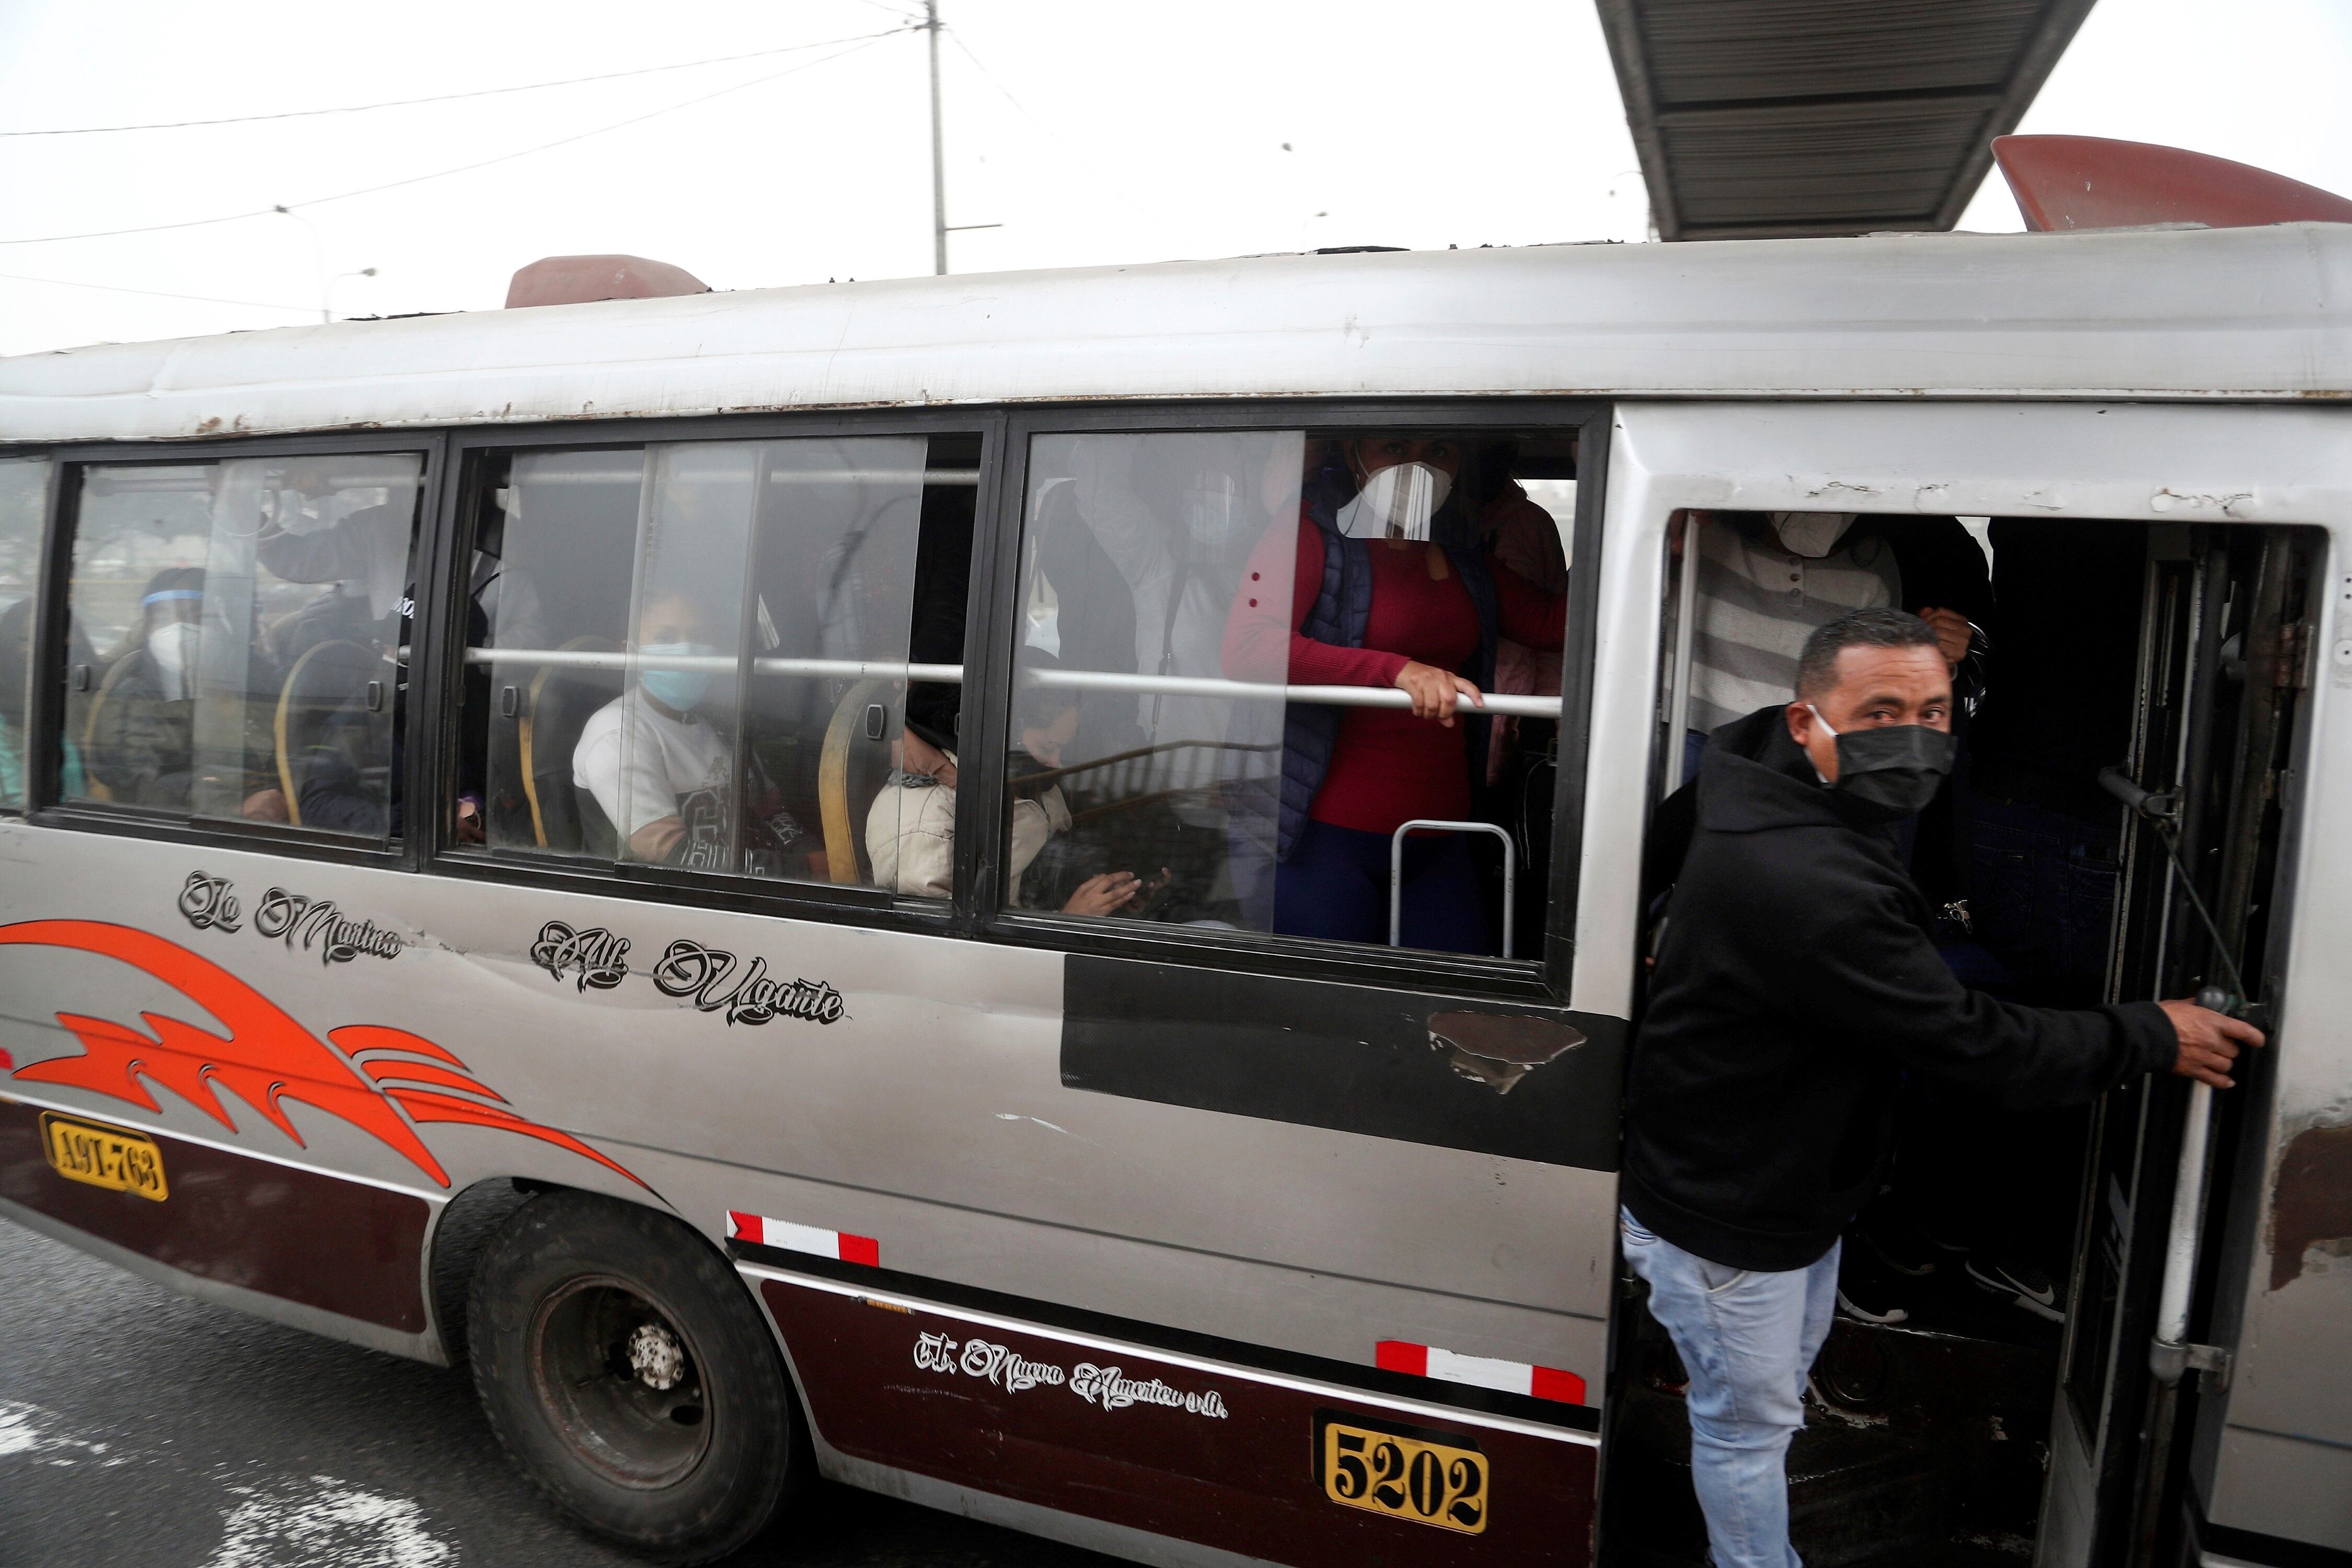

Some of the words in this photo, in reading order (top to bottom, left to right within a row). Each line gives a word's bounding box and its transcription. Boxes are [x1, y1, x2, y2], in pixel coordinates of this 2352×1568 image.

[179, 870, 244, 934] La
[960, 1339, 1066, 1395] Nueva
[1069, 1362, 1185, 1412] America
[1335, 1428, 1482, 1527] 5202
